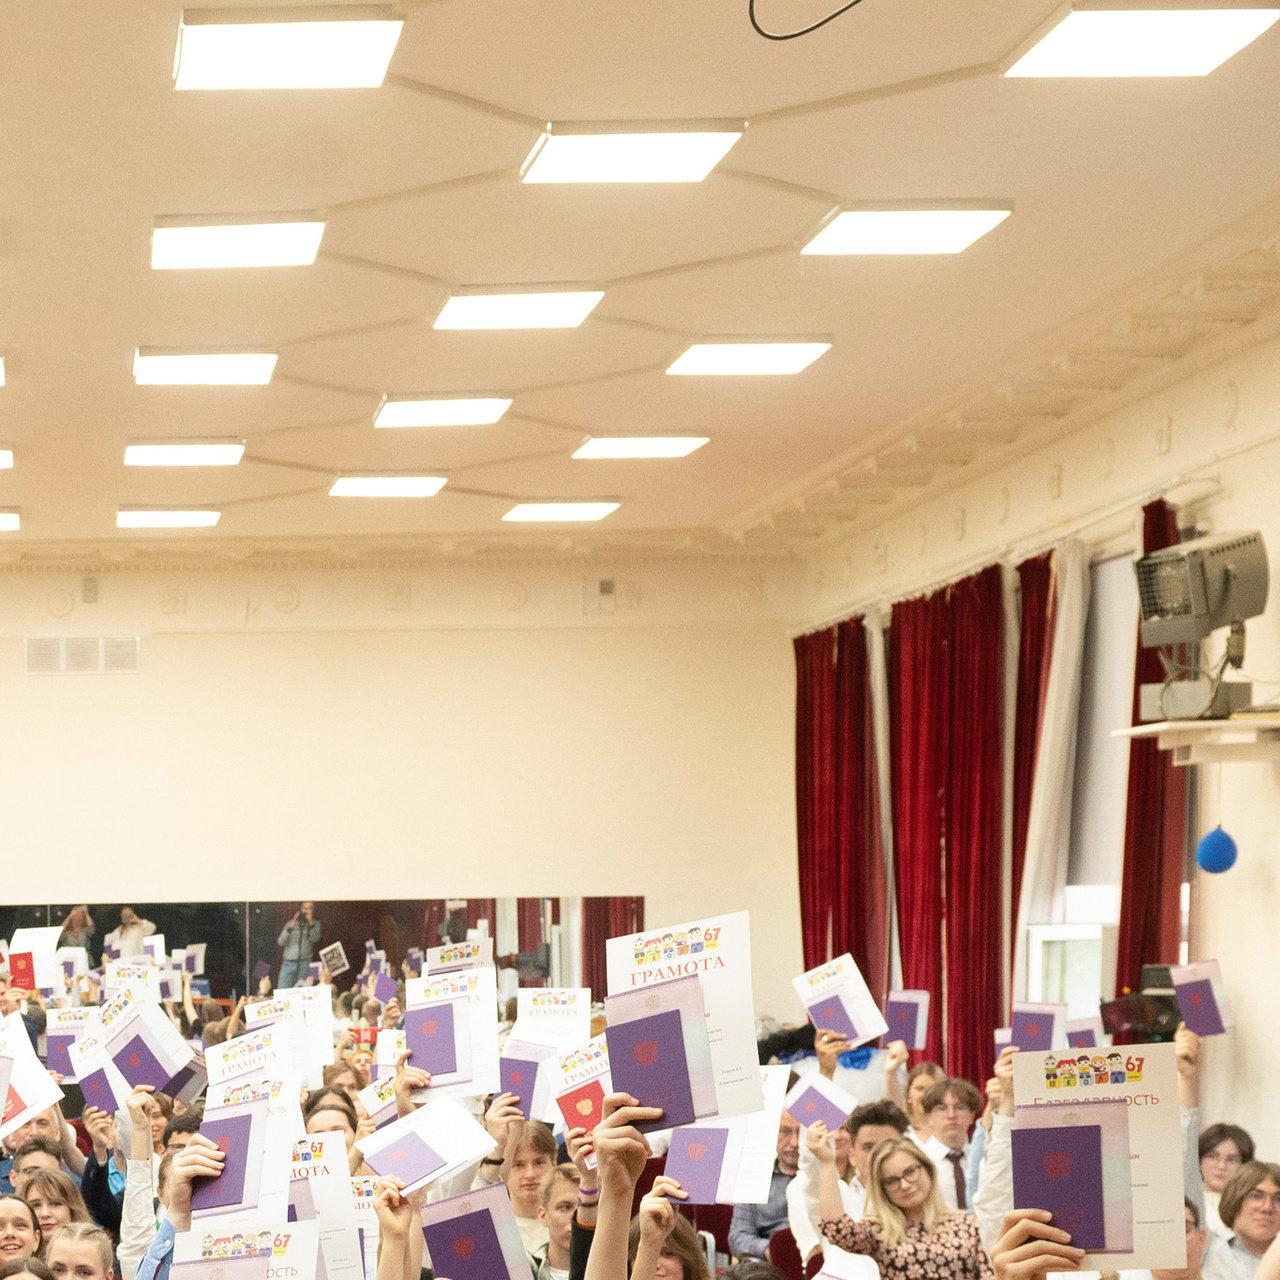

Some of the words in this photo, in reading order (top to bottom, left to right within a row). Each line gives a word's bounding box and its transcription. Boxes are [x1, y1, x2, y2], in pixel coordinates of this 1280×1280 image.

[704, 927, 721, 942] 67
[629, 955, 726, 986] ГРАМОТА
[564, 1059, 609, 1085] ГРАМОТ
[1125, 1056, 1145, 1073] 67
[271, 1081, 283, 1092] 67
[311, 1141, 324, 1153] 67
[273, 1233, 292, 1248] 67
